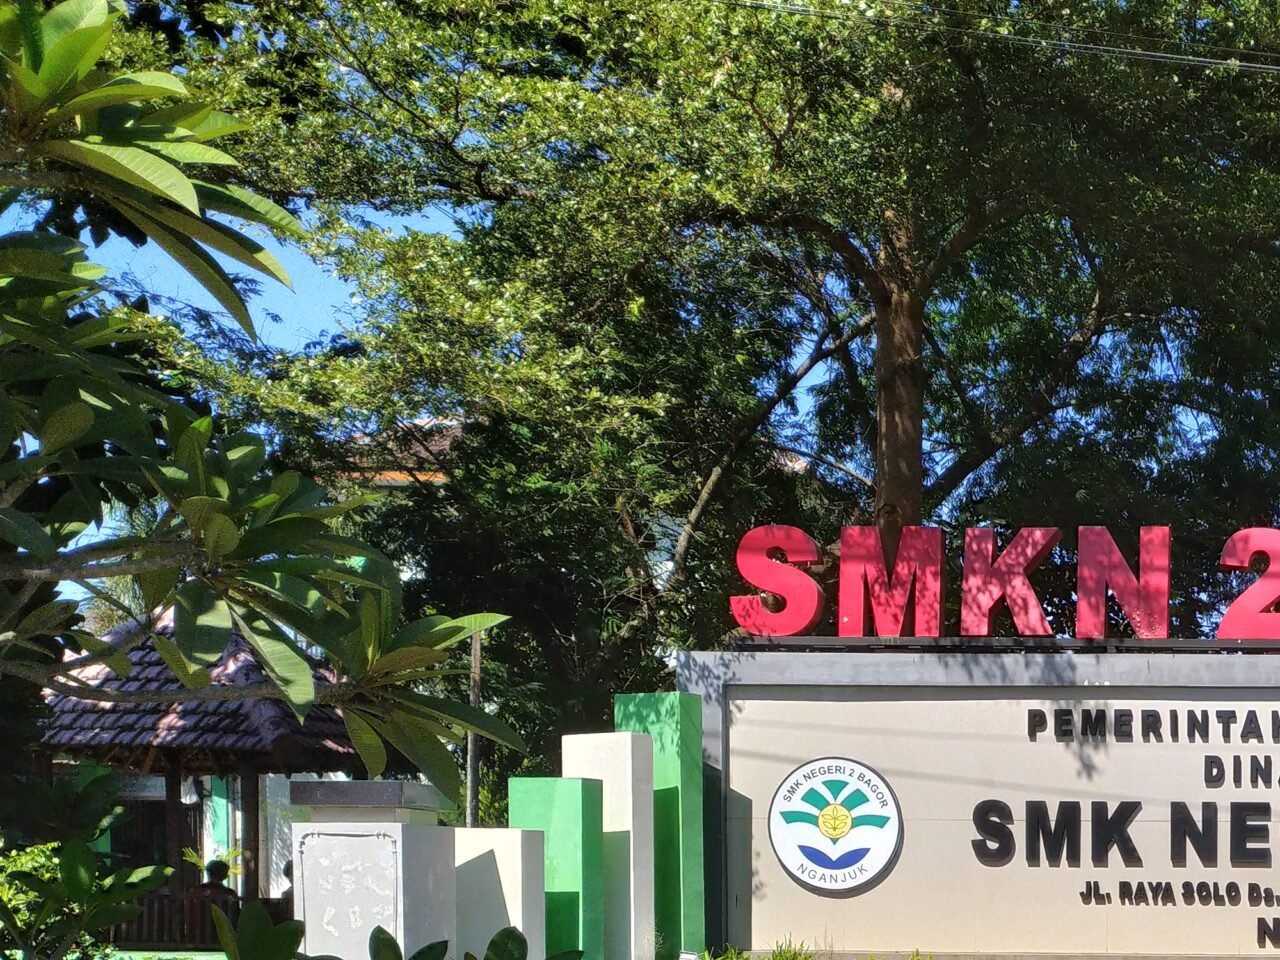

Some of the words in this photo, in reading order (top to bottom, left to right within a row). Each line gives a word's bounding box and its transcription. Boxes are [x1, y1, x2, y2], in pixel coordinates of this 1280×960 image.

[728, 523, 1172, 639] SMKN
[782, 778, 804, 802] SMK
[802, 765, 847, 782] NEGERI
[848, 768, 856, 778] 2
[857, 772, 889, 809] BAGOR
[971, 799, 1144, 868] SMK
[796, 862, 869, 884] NGANJUK
[1079, 881, 1113, 906] JL.
[1118, 881, 1177, 907] RAYA
[1181, 881, 1241, 907] SOLO
